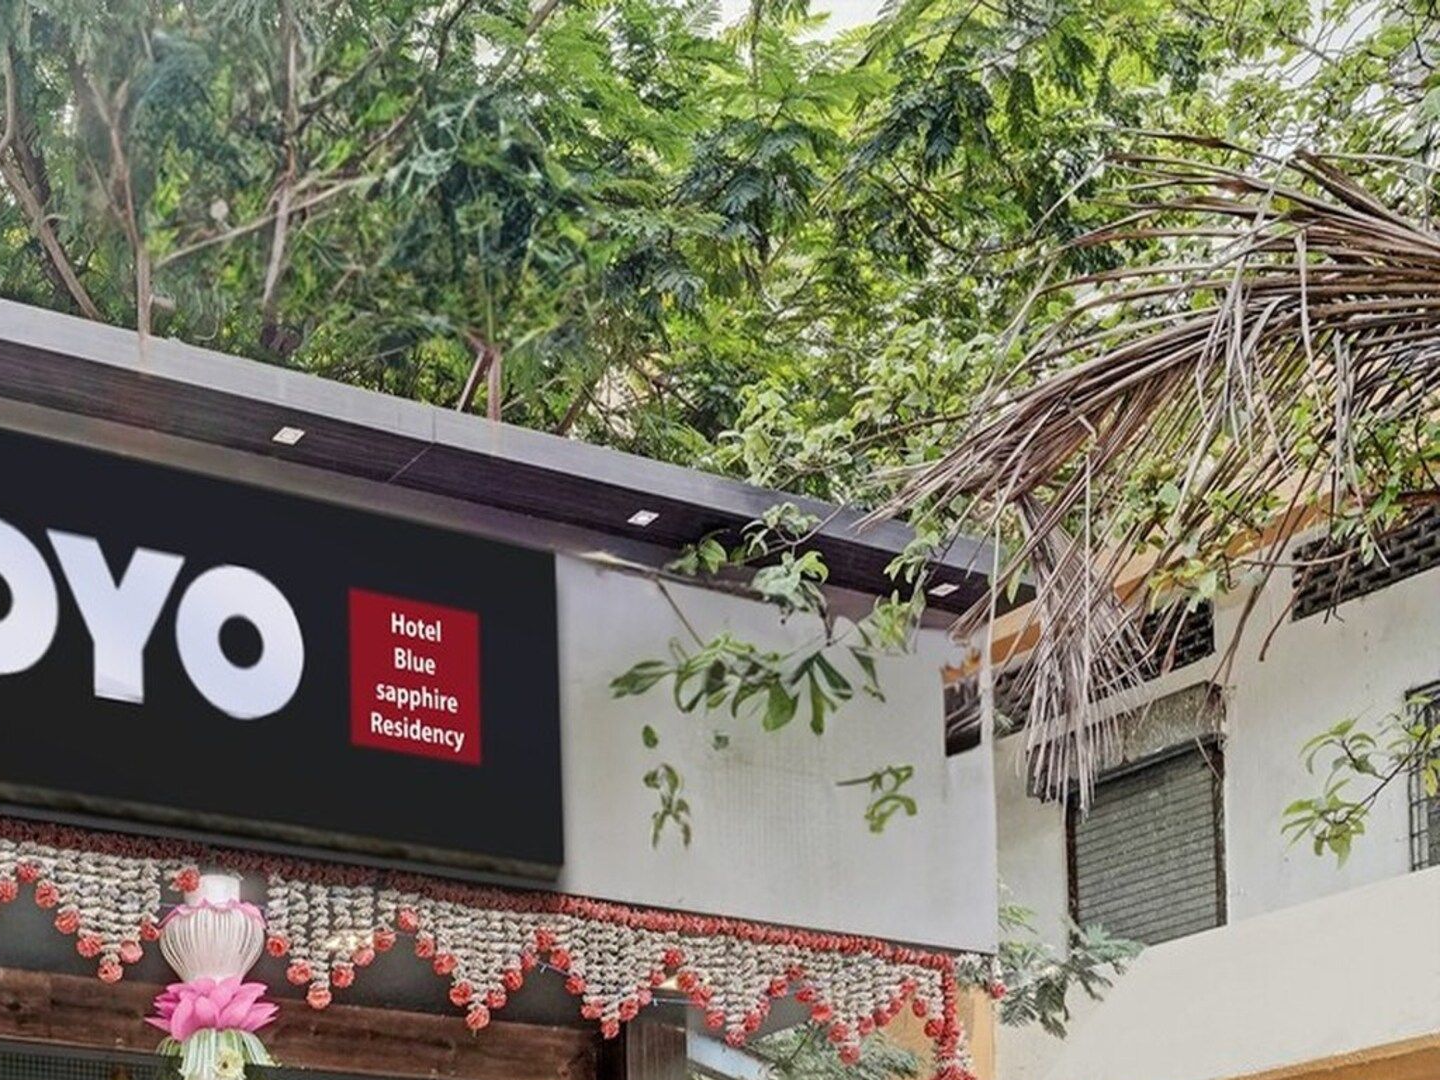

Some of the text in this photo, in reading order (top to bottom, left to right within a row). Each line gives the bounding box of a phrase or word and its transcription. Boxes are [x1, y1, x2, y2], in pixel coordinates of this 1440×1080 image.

[391, 612, 442, 642] Hotel
[394, 647, 436, 675] Blue
[375, 683, 459, 713] sapphire
[370, 711, 465, 752] Residency
